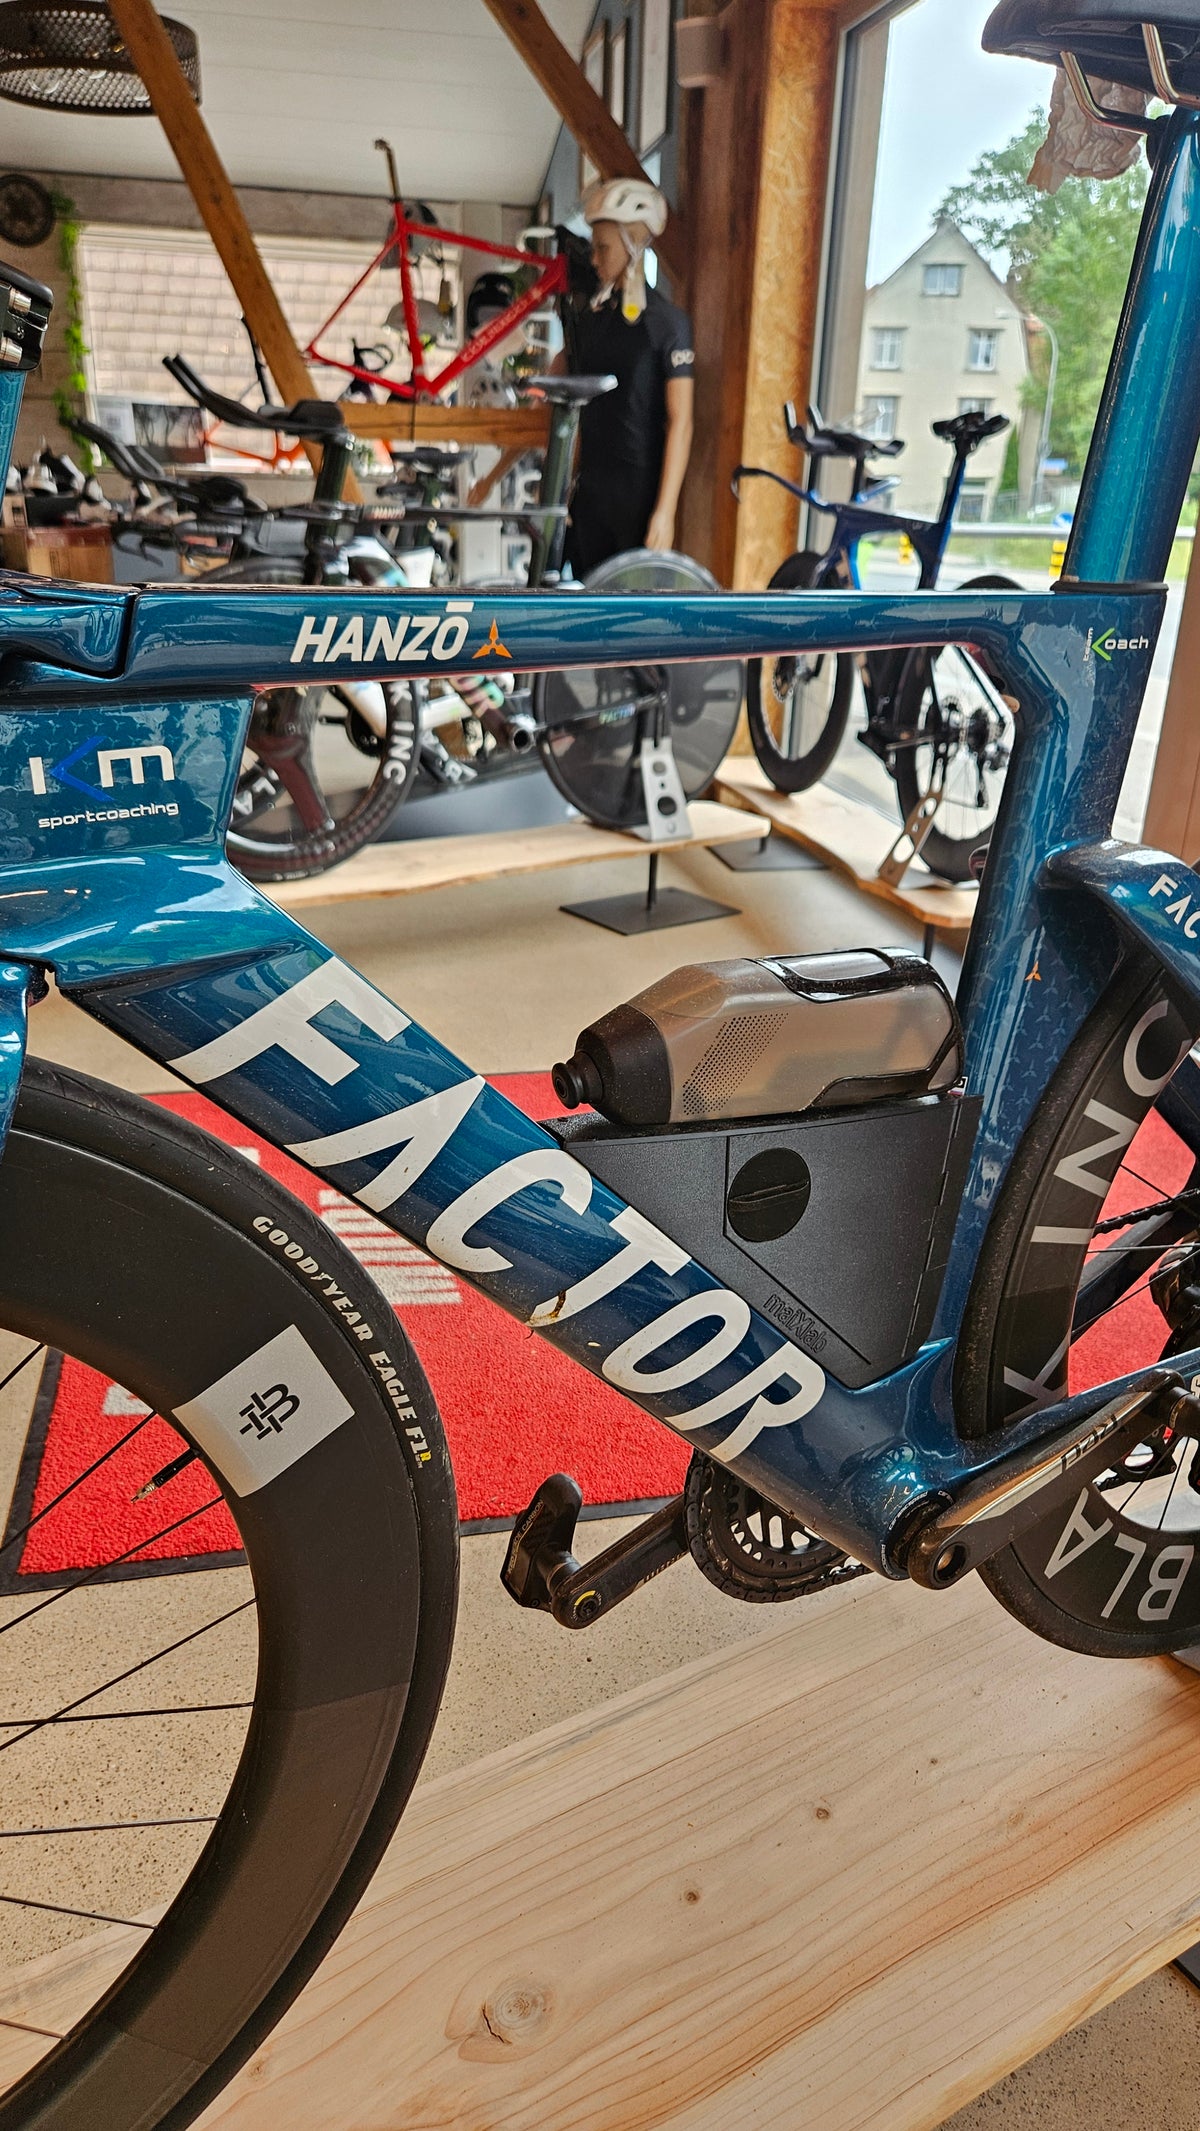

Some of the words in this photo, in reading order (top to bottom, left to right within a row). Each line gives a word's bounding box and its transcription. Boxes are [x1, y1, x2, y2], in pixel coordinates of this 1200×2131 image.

[38, 803, 179, 829] sportcoaching
[165, 956, 826, 1463] FACTOR
[1030, 1000, 1192, 1245] INC
[252, 1216, 374, 1342] GOODYEAR
[369, 1350, 417, 1421] EAGLE
